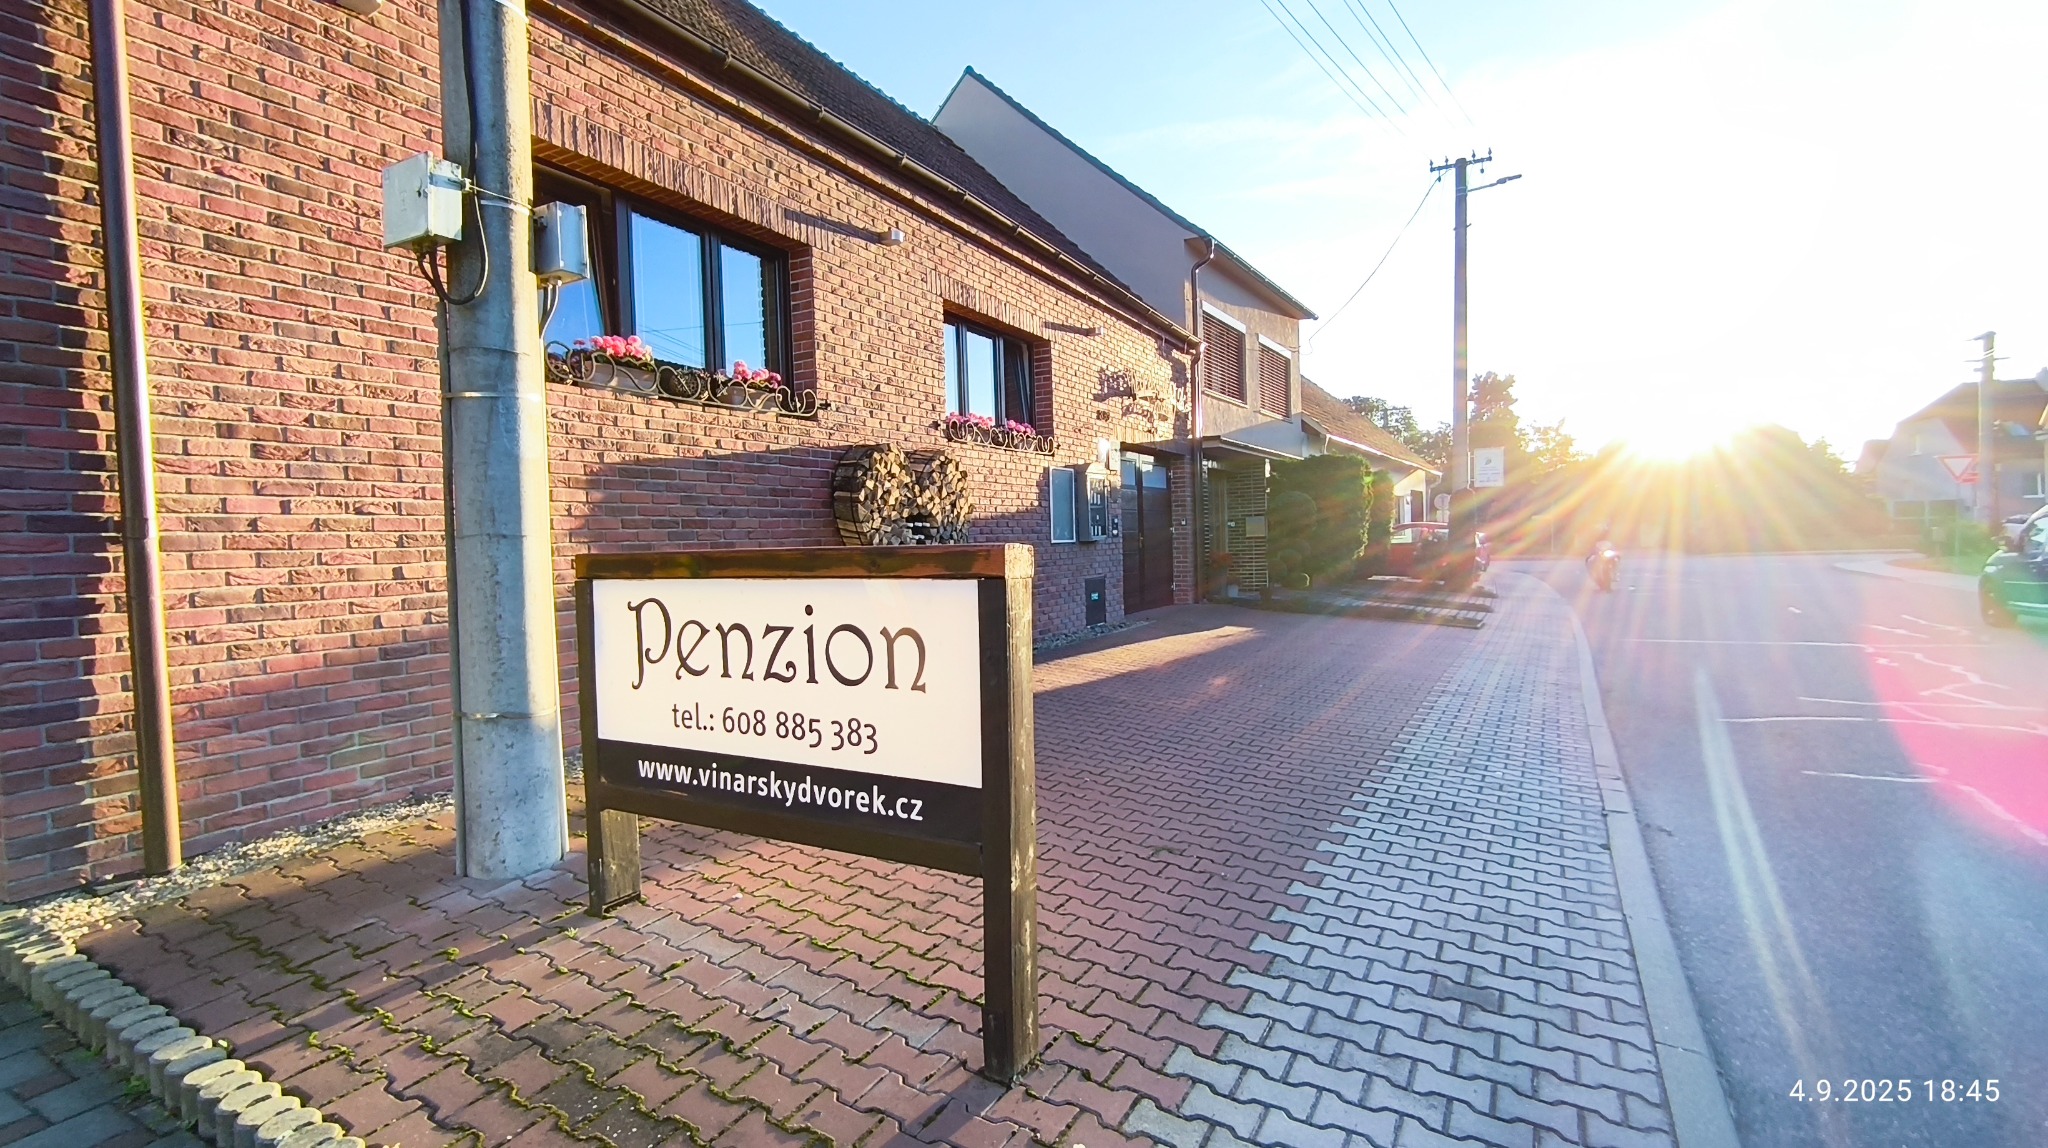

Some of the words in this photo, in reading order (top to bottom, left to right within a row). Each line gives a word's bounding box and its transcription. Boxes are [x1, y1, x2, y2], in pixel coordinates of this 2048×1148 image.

[627, 597, 926, 694] Penzion
[672, 703, 714, 732] tel.:
[722, 706, 766, 737] 608
[776, 712, 822, 749] 885
[830, 720, 878, 755] 383
[638, 758, 924, 821] www.vinarskydvorek.cz
